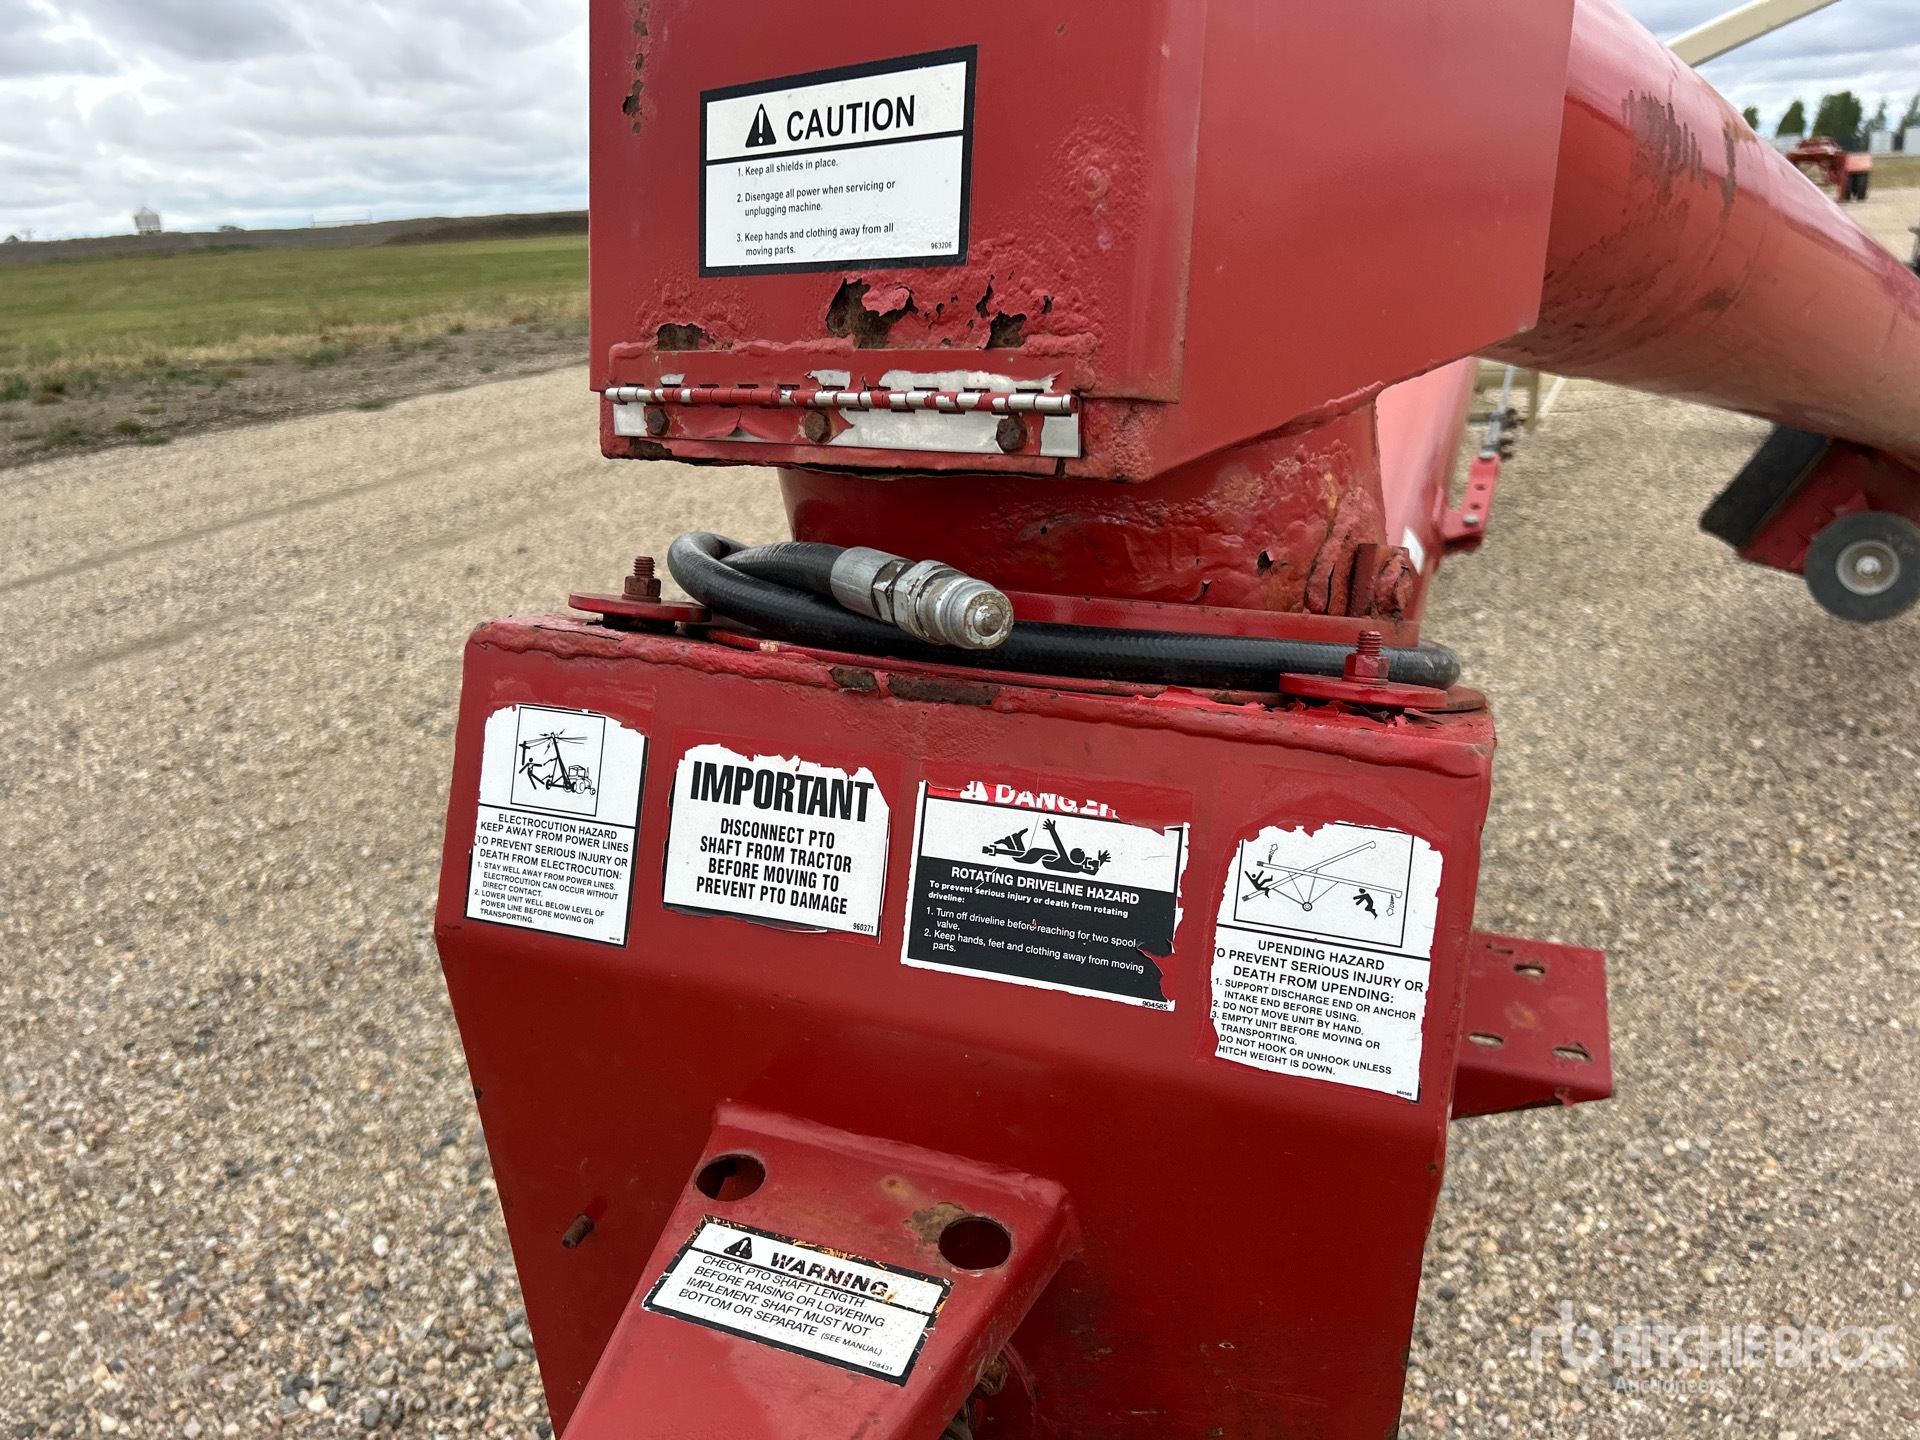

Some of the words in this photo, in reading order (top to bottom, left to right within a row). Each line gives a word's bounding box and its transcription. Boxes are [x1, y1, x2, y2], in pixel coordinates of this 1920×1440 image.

[786, 95, 915, 141] CAUTION
[745, 165, 764, 176] Keep
[776, 160, 803, 173] shields
[814, 158, 838, 170] place.
[744, 191, 783, 202] Disengage
[796, 187, 820, 198] power
[821, 184, 843, 195] when
[845, 180, 884, 193] servicing
[744, 204, 786, 217] unplugging
[788, 202, 822, 213] machine.
[744, 232, 763, 242] Keep
[764, 230, 788, 240] hands
[789, 228, 804, 239] and
[805, 227, 837, 238] clothing
[839, 226, 860, 236] away
[861, 224, 881, 234] from
[930, 241, 952, 249] 963206
[745, 245, 772, 256] moving
[774, 245, 795, 256] parts.
[690, 761, 874, 822] IMPORTANT
[480, 821, 504, 832] KEEP
[505, 825, 533, 837] AWAY
[535, 829, 563, 842] FROM
[564, 834, 600, 848] POWER
[602, 840, 629, 852] LINES
[498, 813, 576, 833] ELECTROCUTION
[578, 825, 617, 839] HAZARD
[720, 817, 804, 844] DISCONNECT
[808, 829, 835, 849] PTO
[479, 848, 509, 861] DEATH
[511, 853, 538, 866] FROM
[540, 858, 622, 879] ELECTROCUTION:
[490, 837, 533, 852] PREVENT
[534, 844, 576, 859] SERIOUS
[578, 851, 612, 864] INJURY
[613, 856, 628, 867] OR
[699, 835, 742, 856] SHAFT
[745, 841, 785, 863] FROM
[790, 847, 852, 873] TRACTOR
[482, 880, 507, 891] DIRECT
[508, 885, 542, 897] CONTACT.
[483, 861, 501, 870] STAY
[502, 865, 520, 874] WELL
[521, 868, 542, 878] AWAY
[543, 871, 564, 881] FROM
[565, 875, 592, 886] POWER
[593, 880, 615, 890] LINES.
[483, 871, 541, 887] ELECTROCUTION
[558, 884, 585, 895] OCCUR
[586, 888, 618, 900] WITHOUT
[708, 857, 759, 880] BEFORE
[763, 864, 817, 889] MOVING
[822, 873, 839, 892] TO
[951, 866, 1013, 886] ROTATING
[1016, 876, 1083, 896] DRIVELINE
[1086, 886, 1139, 904] HAZARD
[480, 898, 505, 909] POWER
[523, 906, 552, 918] BEFORE
[553, 911, 582, 923] MOVING
[481, 889, 506, 900] LOWER
[506, 894, 523, 903] UNIT
[524, 897, 543, 907] WELL
[544, 900, 571, 911] BELOW
[571, 905, 593, 916] LEVEL
[696, 875, 756, 899] PREVENT
[759, 885, 786, 904] PTO
[789, 889, 847, 915] DAMAGE
[927, 890, 965, 903] driveline:
[941, 883, 973, 893] prevent
[973, 886, 1005, 898] serious
[1006, 891, 1031, 903] injury
[1043, 897, 1069, 908] death
[1071, 901, 1092, 911] from
[1093, 906, 1128, 918] rotating
[479, 907, 534, 923] TRANSPORTING.
[852, 922, 874, 932] 960371
[935, 907, 954, 918] Turn
[969, 912, 1005, 926] driveline
[1037, 924, 1075, 939] reaching
[1092, 932, 1108, 943] two
[1111, 936, 1136, 948] spool
[936, 919, 960, 930] valve.
[932, 942, 956, 952] parts.
[933, 929, 956, 942] Keep
[957, 932, 986, 947] hands,
[988, 937, 1005, 949] feet
[1006, 942, 1023, 952] and
[1025, 944, 1061, 960] clothing
[1062, 952, 1086, 964] away
[1088, 954, 1109, 966] from
[1110, 960, 1144, 974] moving
[1257, 939, 1325, 960] UPENDING
[1329, 951, 1384, 970] HAZARD
[1228, 949, 1288, 969] PREVENT
[1290, 960, 1349, 979] SERIOUS
[1352, 970, 1401, 988] INJURY
[1404, 979, 1423, 992] OR
[1233, 965, 1275, 982] DEATH
[1279, 973, 1317, 990] FROM
[1321, 981, 1394, 1003] UPENDING:
[1224, 979, 1269, 994] SUPPORT
[1271, 987, 1329, 1005] DISCHARGE
[1331, 998, 1353, 1009] END
[1355, 1002, 1370, 1013] OR
[1372, 1006, 1416, 1020] ANCHOR
[1224, 990, 1258, 1004] INTAKE
[1260, 997, 1280, 1008] END
[1282, 1001, 1323, 1016] BEFORE
[1325, 1009, 1359, 1022] USING.
[1220, 1022, 1297, 1045] TRANSPORTING.
[1221, 1012, 1253, 1025] EMPTY
[1255, 1018, 1278, 1030] UNIT
[1279, 1023, 1319, 1038] BEFORE
[1322, 1031, 1362, 1046] MOVING
[1365, 1039, 1380, 1049] OR
[1238, 1004, 1259, 1015] NOT
[1261, 1008, 1289, 1021] MOVE
[1291, 1014, 1315, 1025] UNIT
[1316, 1018, 1330, 1028] BY
[1332, 1021, 1363, 1035] HAND.
[1218, 1045, 1247, 1057] HITCH
[1249, 1050, 1288, 1065] WEIGHT
[1301, 1061, 1335, 1075] DOWN.
[1235, 1037, 1256, 1047] NOT
[1257, 1041, 1286, 1054] HOOK
[1289, 1047, 1304, 1057] OR
[1306, 1051, 1350, 1066] UNHOOK
[1352, 1060, 1391, 1074] UNLESS
[702, 1255, 745, 1273] CHECK
[745, 1267, 771, 1280] PTO
[771, 1274, 814, 1292] SHAFT
[813, 1286, 866, 1307] LENGTH
[770, 1251, 889, 1297] WARNING
[678, 1288, 733, 1310] BOTTOM
[733, 1304, 753, 1317] OR
[753, 1310, 818, 1336] SEPARATE
[685, 1277, 759, 1305] IMPLEMENT.
[760, 1298, 803, 1316] SHAFT
[802, 1310, 842, 1328] MUST
[841, 1321, 871, 1336] NOT
[693, 1266, 744, 1286] BEFORE
[743, 1280, 795, 1301] RAISING
[795, 1295, 816, 1307] OR
[816, 1300, 885, 1327] LOWERING
[820, 1332, 841, 1343] (SEE
[841, 1338, 882, 1356] MANUAL)
